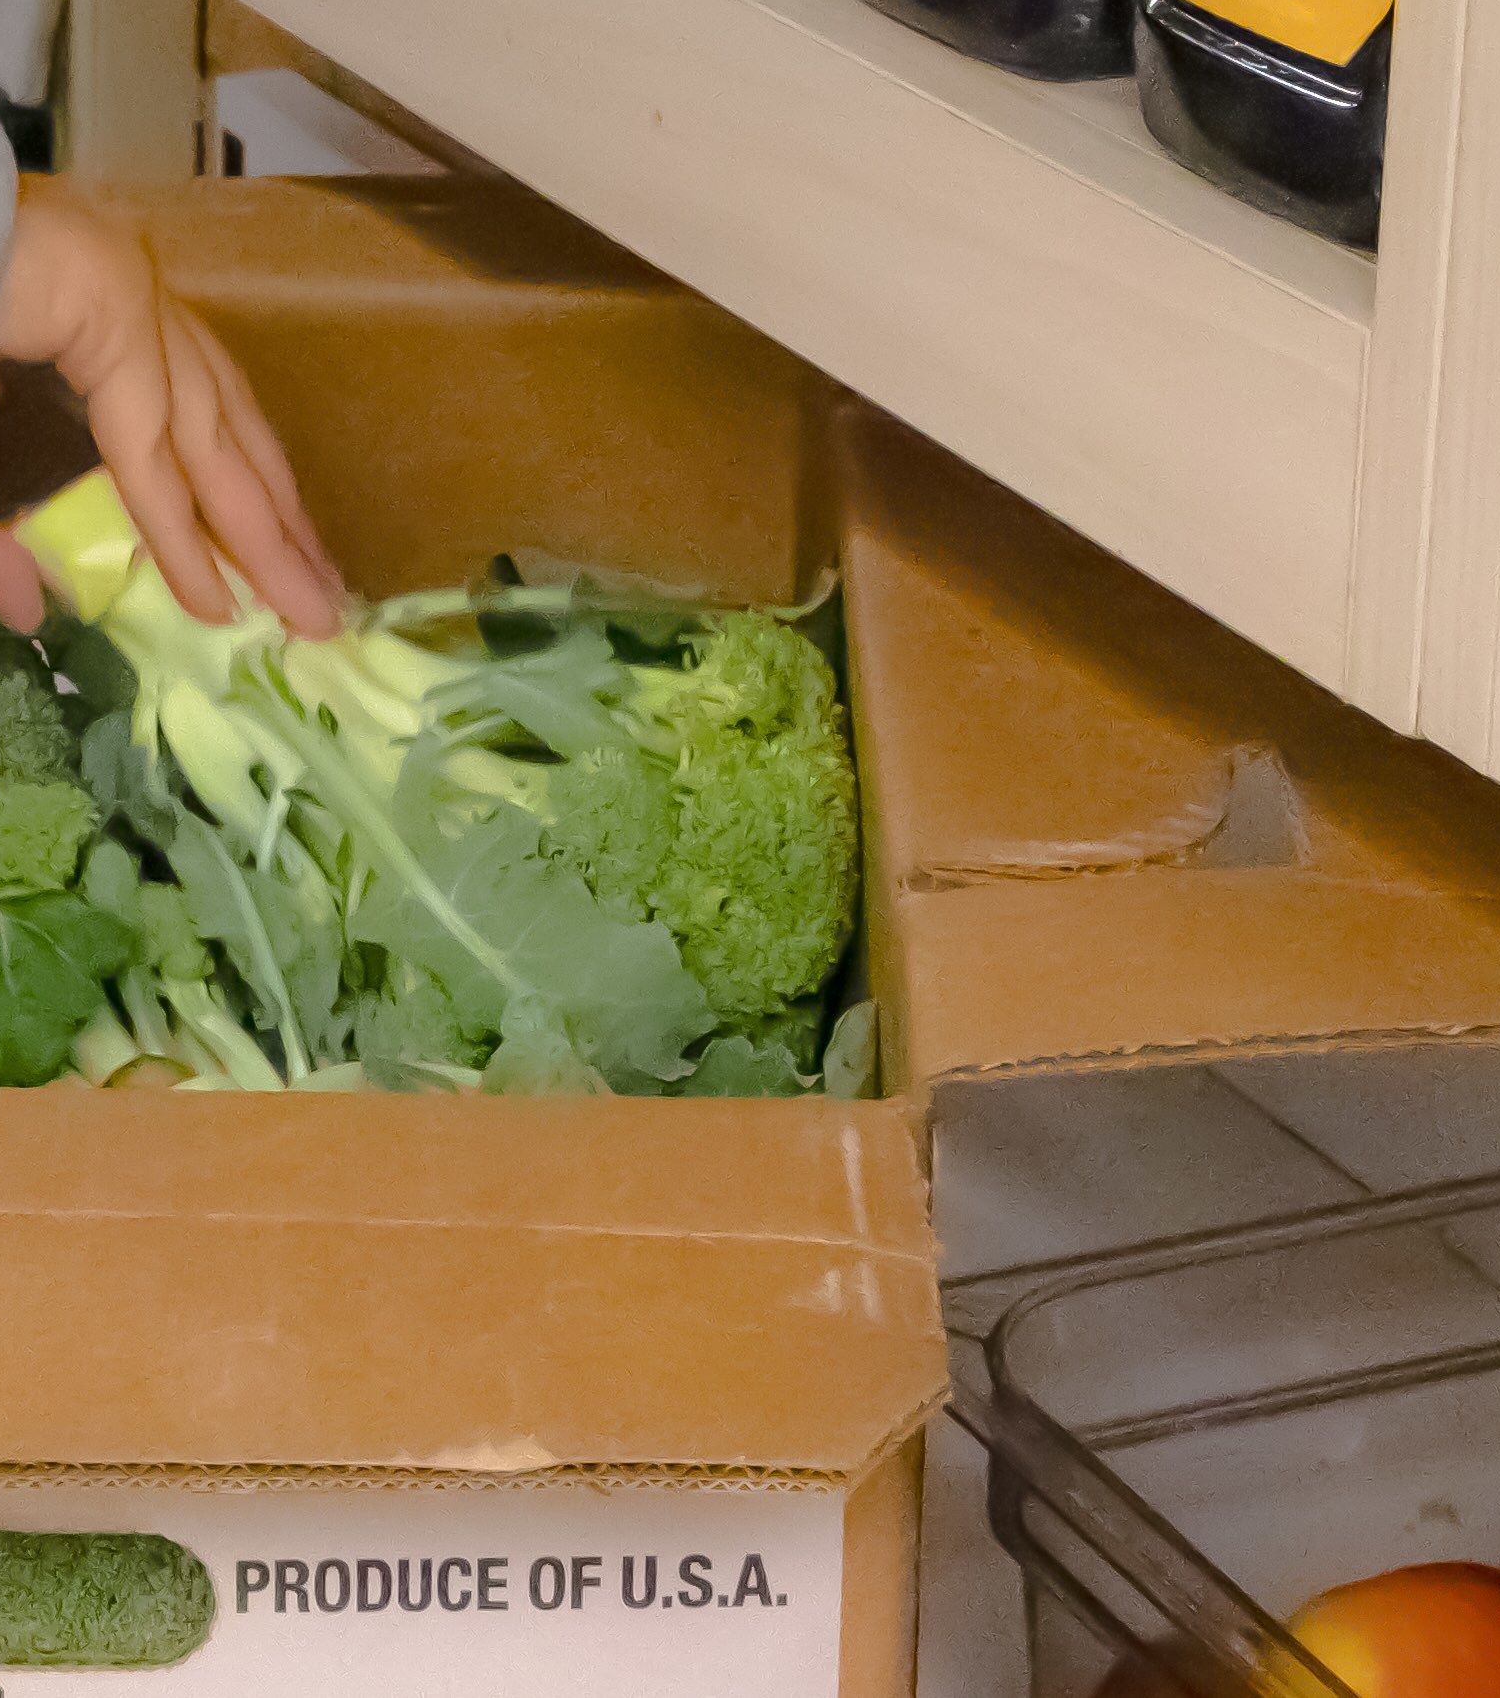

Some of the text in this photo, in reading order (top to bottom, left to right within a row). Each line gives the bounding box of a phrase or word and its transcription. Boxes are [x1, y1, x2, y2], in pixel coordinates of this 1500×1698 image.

[234, 1552, 789, 1614] PRODUCE OF U.S.A.
